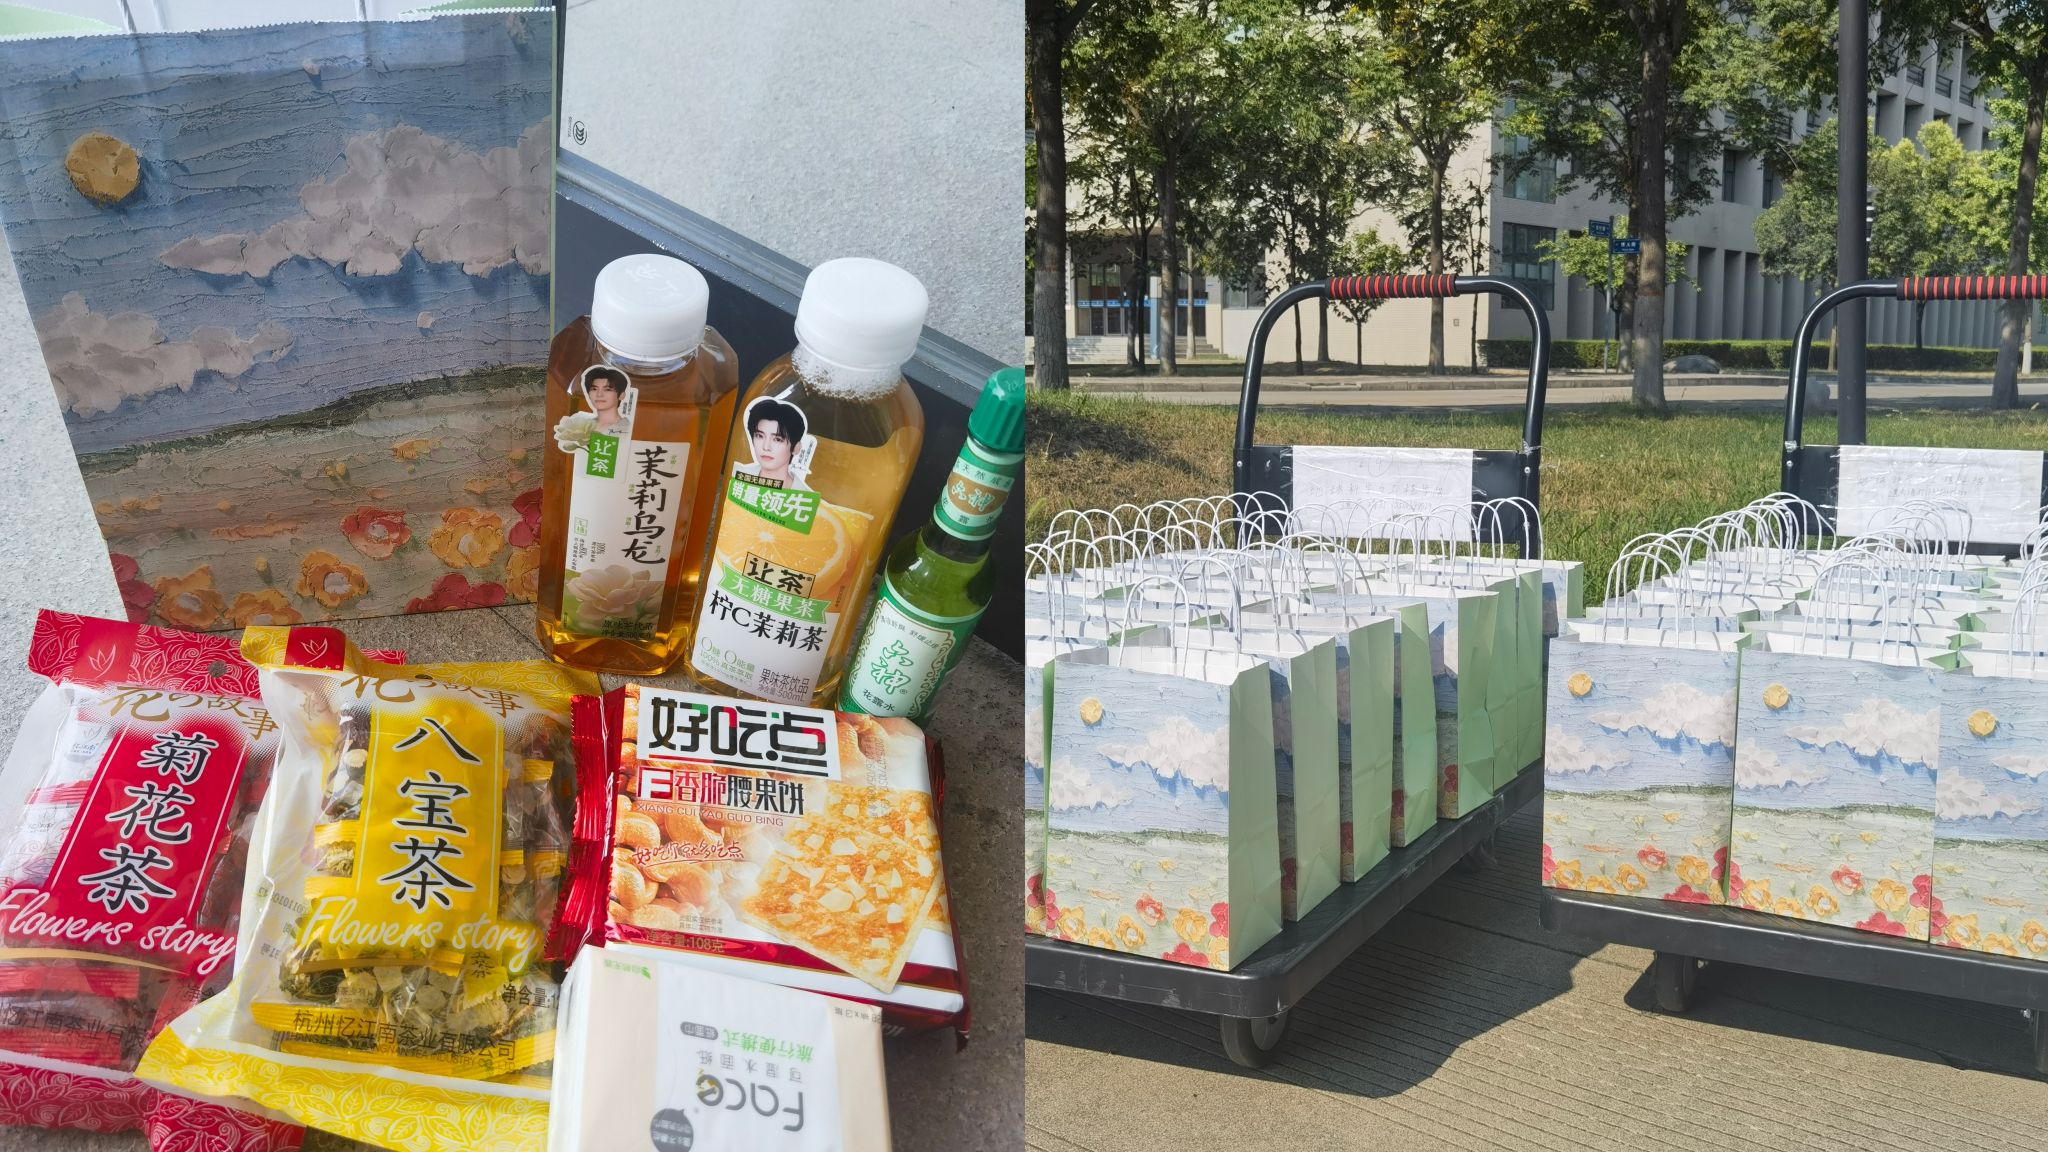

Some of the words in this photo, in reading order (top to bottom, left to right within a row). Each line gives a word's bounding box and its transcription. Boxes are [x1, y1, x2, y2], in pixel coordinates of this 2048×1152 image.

[592, 439, 613, 474] 让茶
[736, 471, 783, 488] 全国无糖果茶
[620, 445, 679, 565] 茉莉乌龙
[732, 480, 813, 523] 销量领先
[730, 576, 817, 618] 无糖果茶
[747, 557, 806, 595] 让茶
[709, 589, 828, 652] 柠C茉莉茶
[100, 685, 280, 741] 花の故事
[863, 688, 896, 712] 花露水
[649, 697, 827, 768] 好吃点
[377, 716, 485, 913] 八宝茶
[637, 803, 674, 816] XIANG
[676, 806, 697, 818] CUI
[701, 809, 723, 820] YAO
[727, 812, 752, 823] GUO
[755, 815, 784, 827] BING
[674, 770, 804, 816] 香脆腰果饼
[77, 731, 220, 915] 菊花茶
[0, 887, 134, 945] Flowers
[139, 917, 236, 976] story
[301, 893, 442, 950] Flowers
[451, 911, 539, 973] story
[293, 1009, 516, 1061] 杭州忆江南茶业有限公司
[721, 1028, 814, 1063] 旅行便携式
[696, 1049, 802, 1083] 可湿水面纸
[697, 1073, 805, 1132] Face
